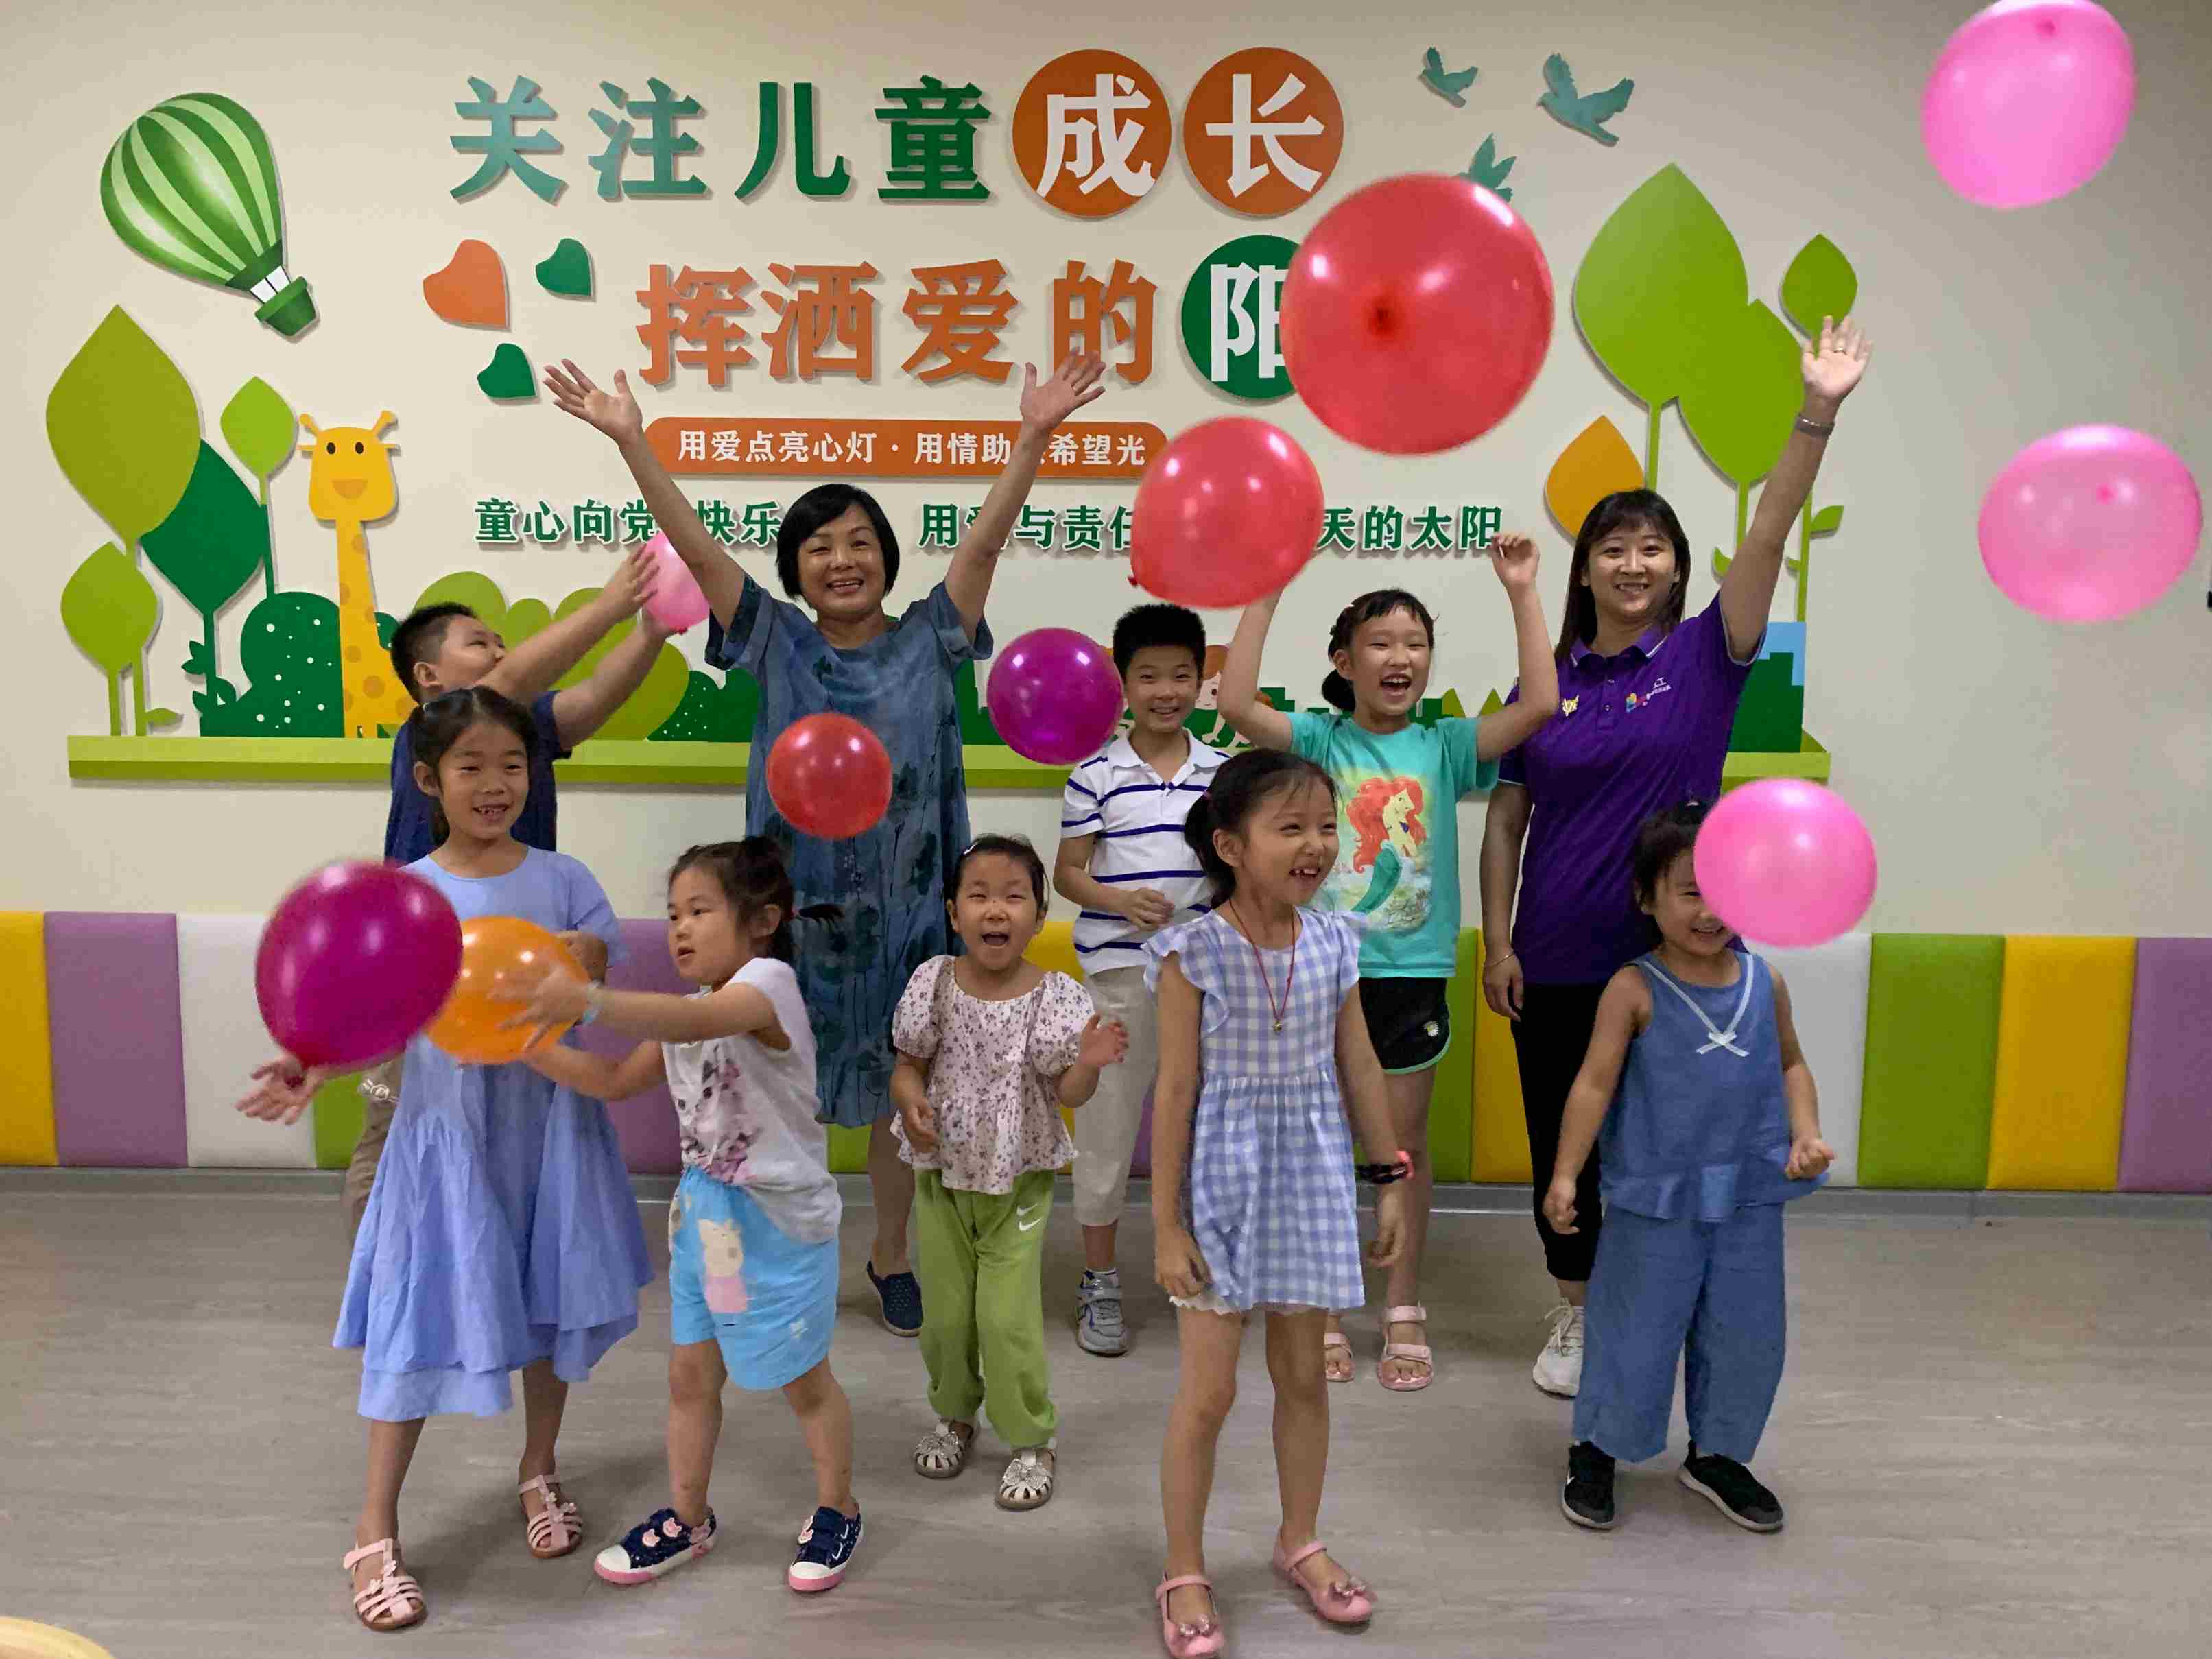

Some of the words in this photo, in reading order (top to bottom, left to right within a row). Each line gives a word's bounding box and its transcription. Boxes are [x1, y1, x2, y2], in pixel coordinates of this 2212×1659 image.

[450, 73, 1325, 204] 关注儿童成长
